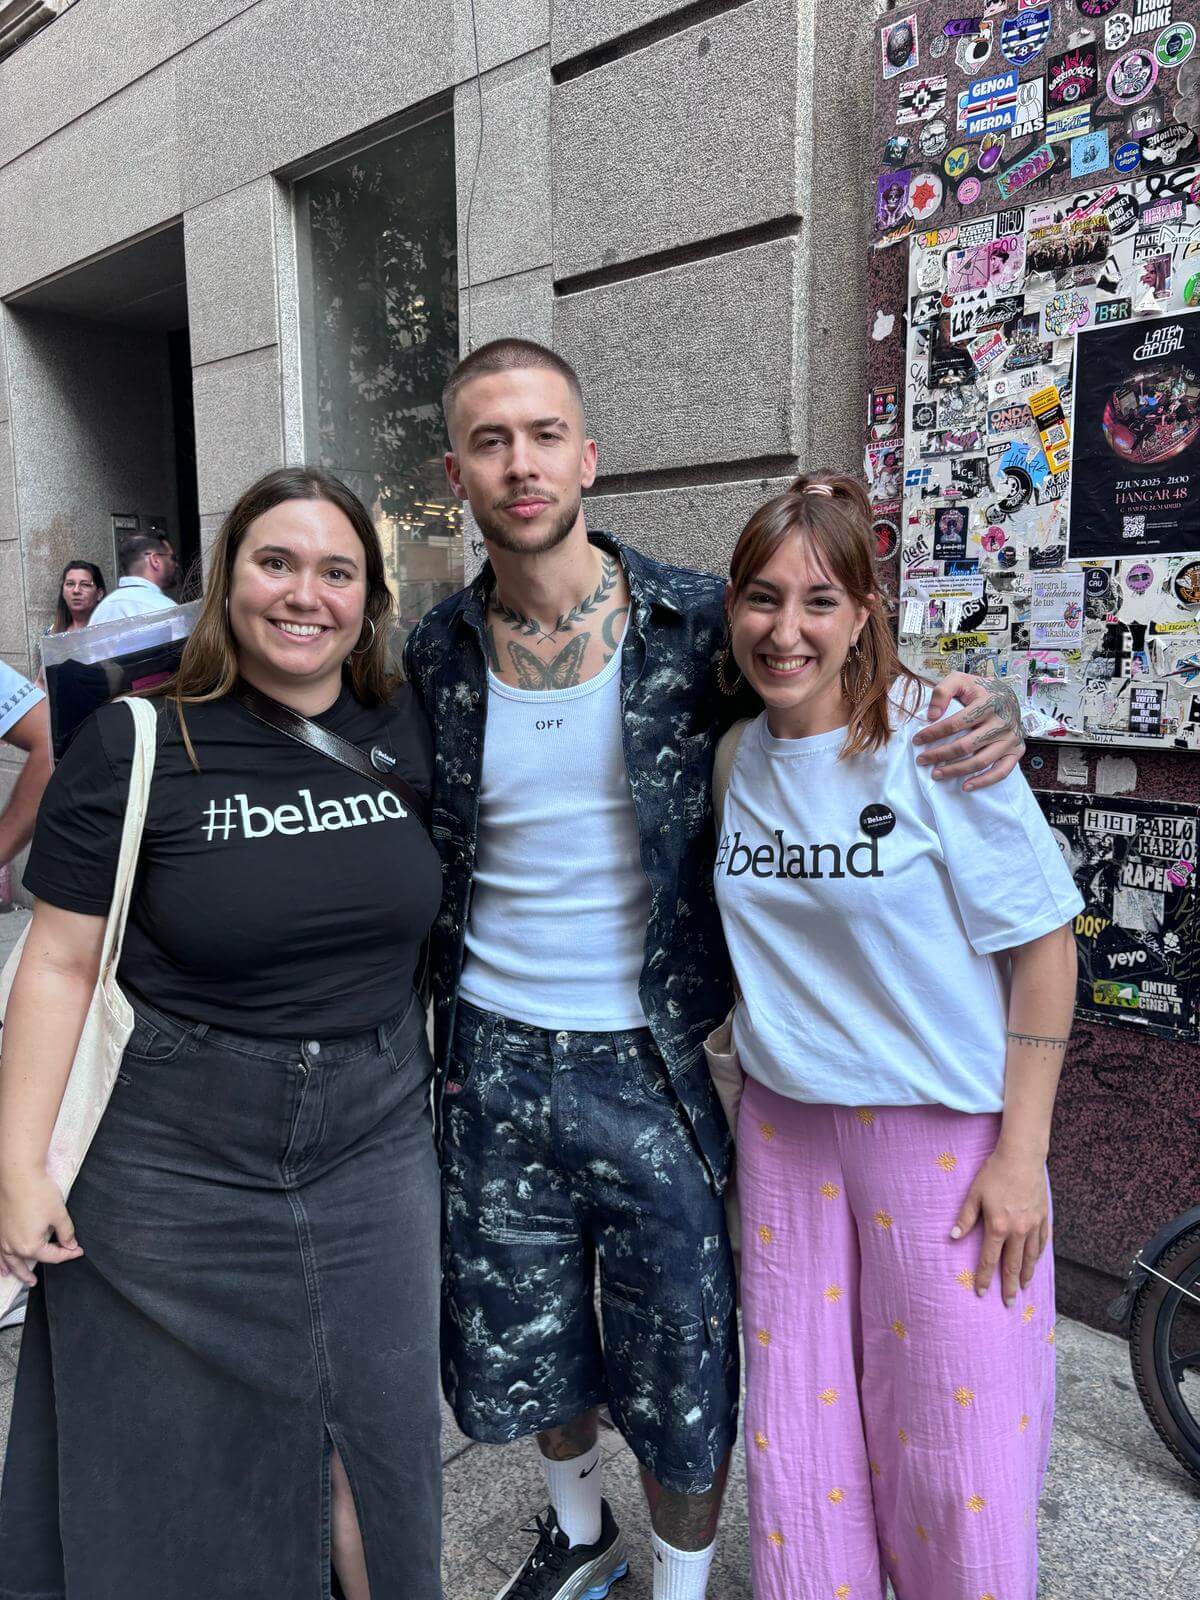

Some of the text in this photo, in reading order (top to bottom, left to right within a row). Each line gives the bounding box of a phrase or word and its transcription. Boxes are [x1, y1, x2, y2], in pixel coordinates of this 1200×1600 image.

[1133, 6, 1172, 35] DHOKE
[972, 75, 1014, 97] GENOA
[969, 113, 1012, 134] MERDA
[1010, 116, 1045, 139] DAS
[991, 406, 1031, 422] ONDA
[1115, 487, 1187, 504] HANGAR 48
[1034, 580, 1059, 591] integra
[1060, 580, 1067, 589] la
[1033, 598, 1054, 607] de tus
[535, 718, 564, 731] OFF
[1107, 950, 1147, 969] yeyo
